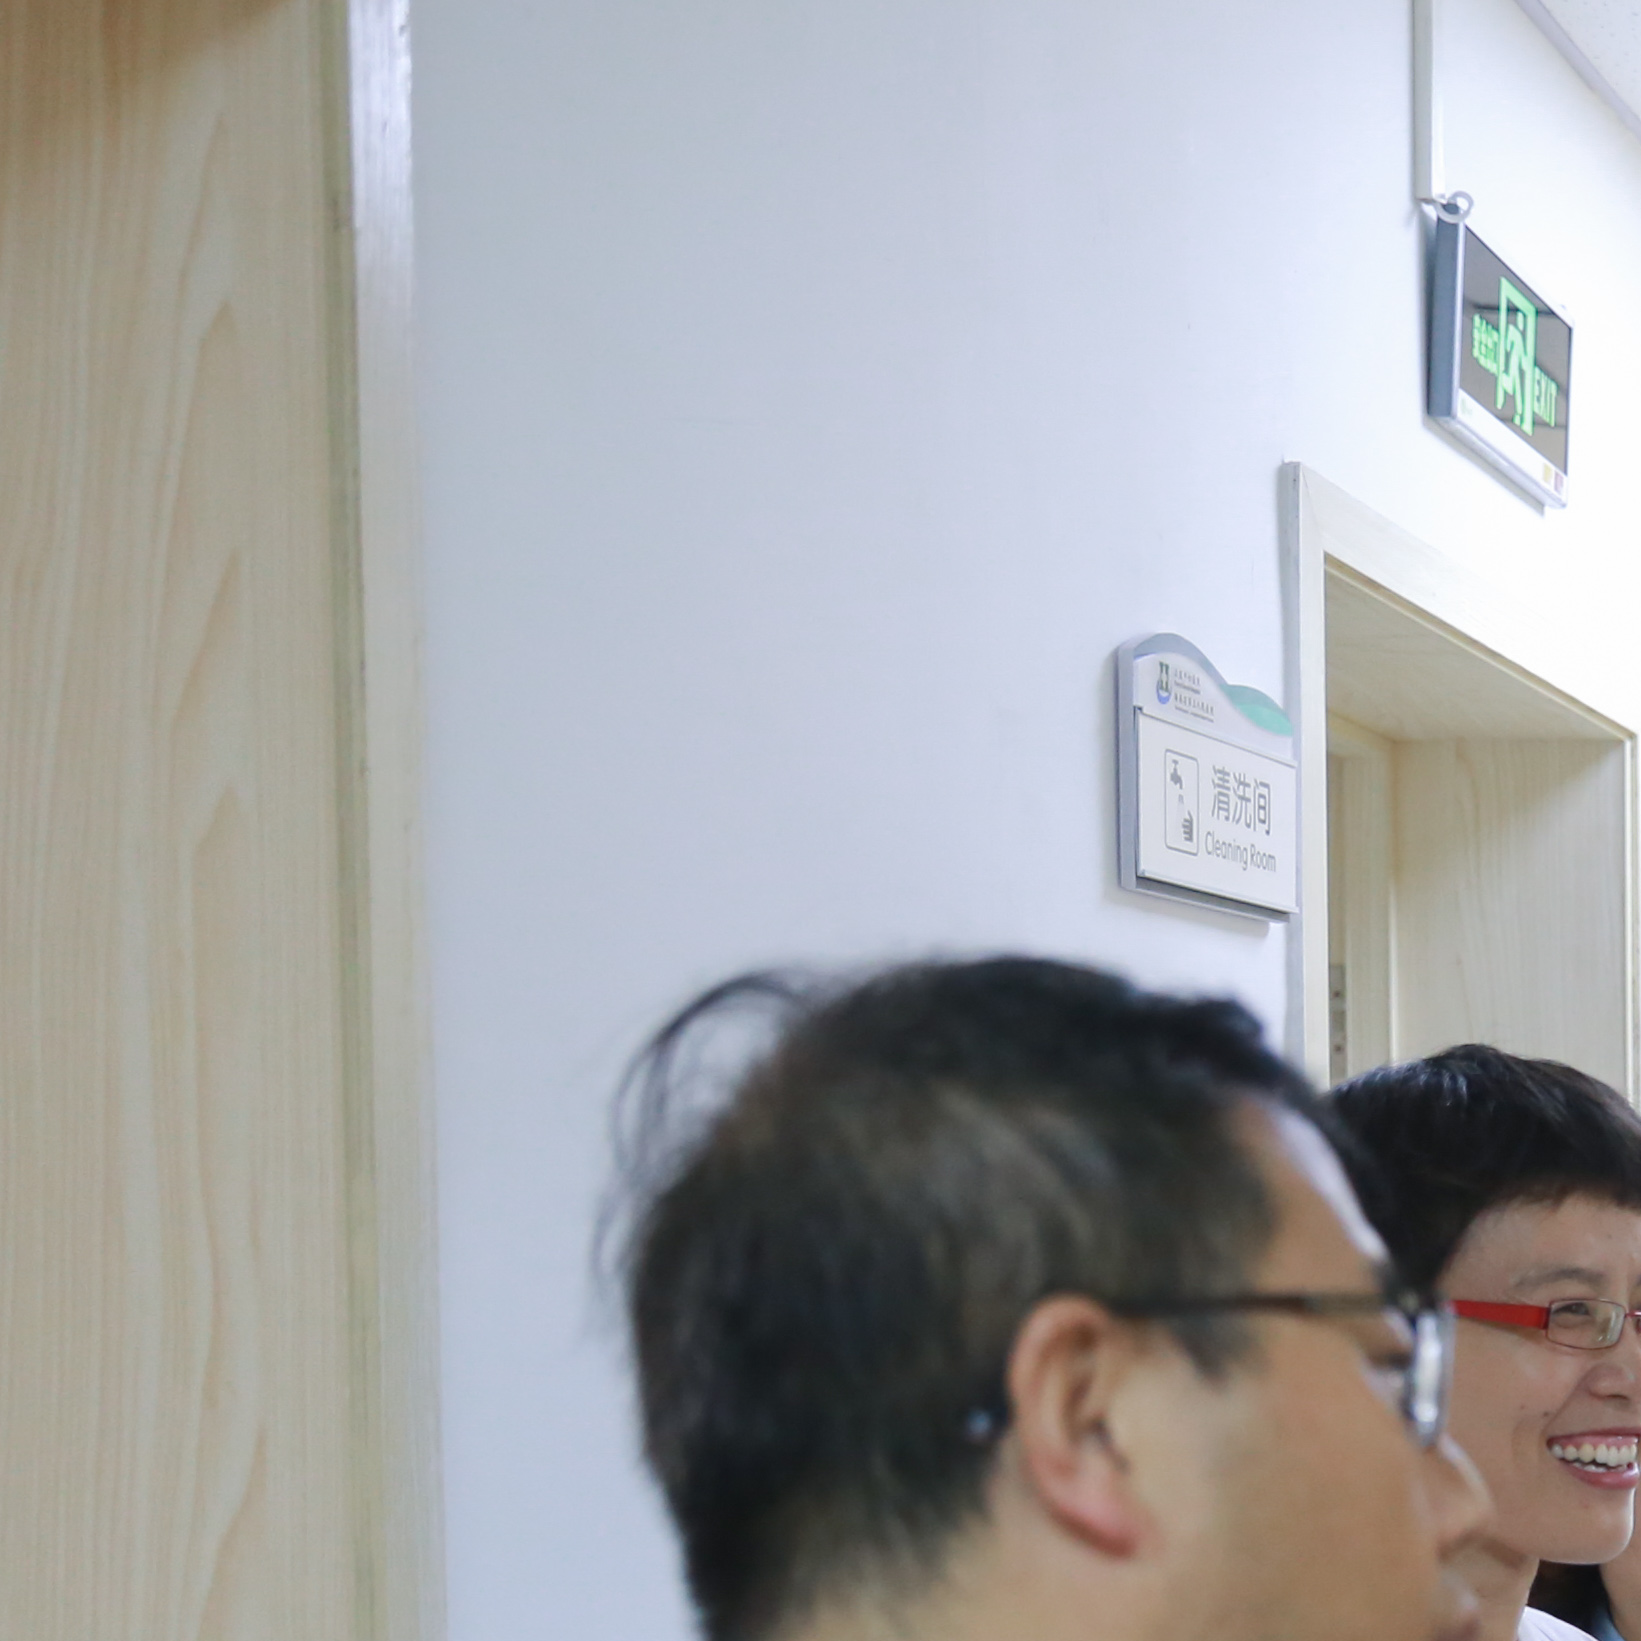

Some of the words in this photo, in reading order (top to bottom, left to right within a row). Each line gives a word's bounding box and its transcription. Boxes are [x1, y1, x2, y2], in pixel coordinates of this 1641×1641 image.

[1533, 364, 1558, 428] EXIT
[1211, 764, 1271, 836] 清洗间
[1205, 831, 1248, 871] Cleaning
[1250, 843, 1276, 872] Room
